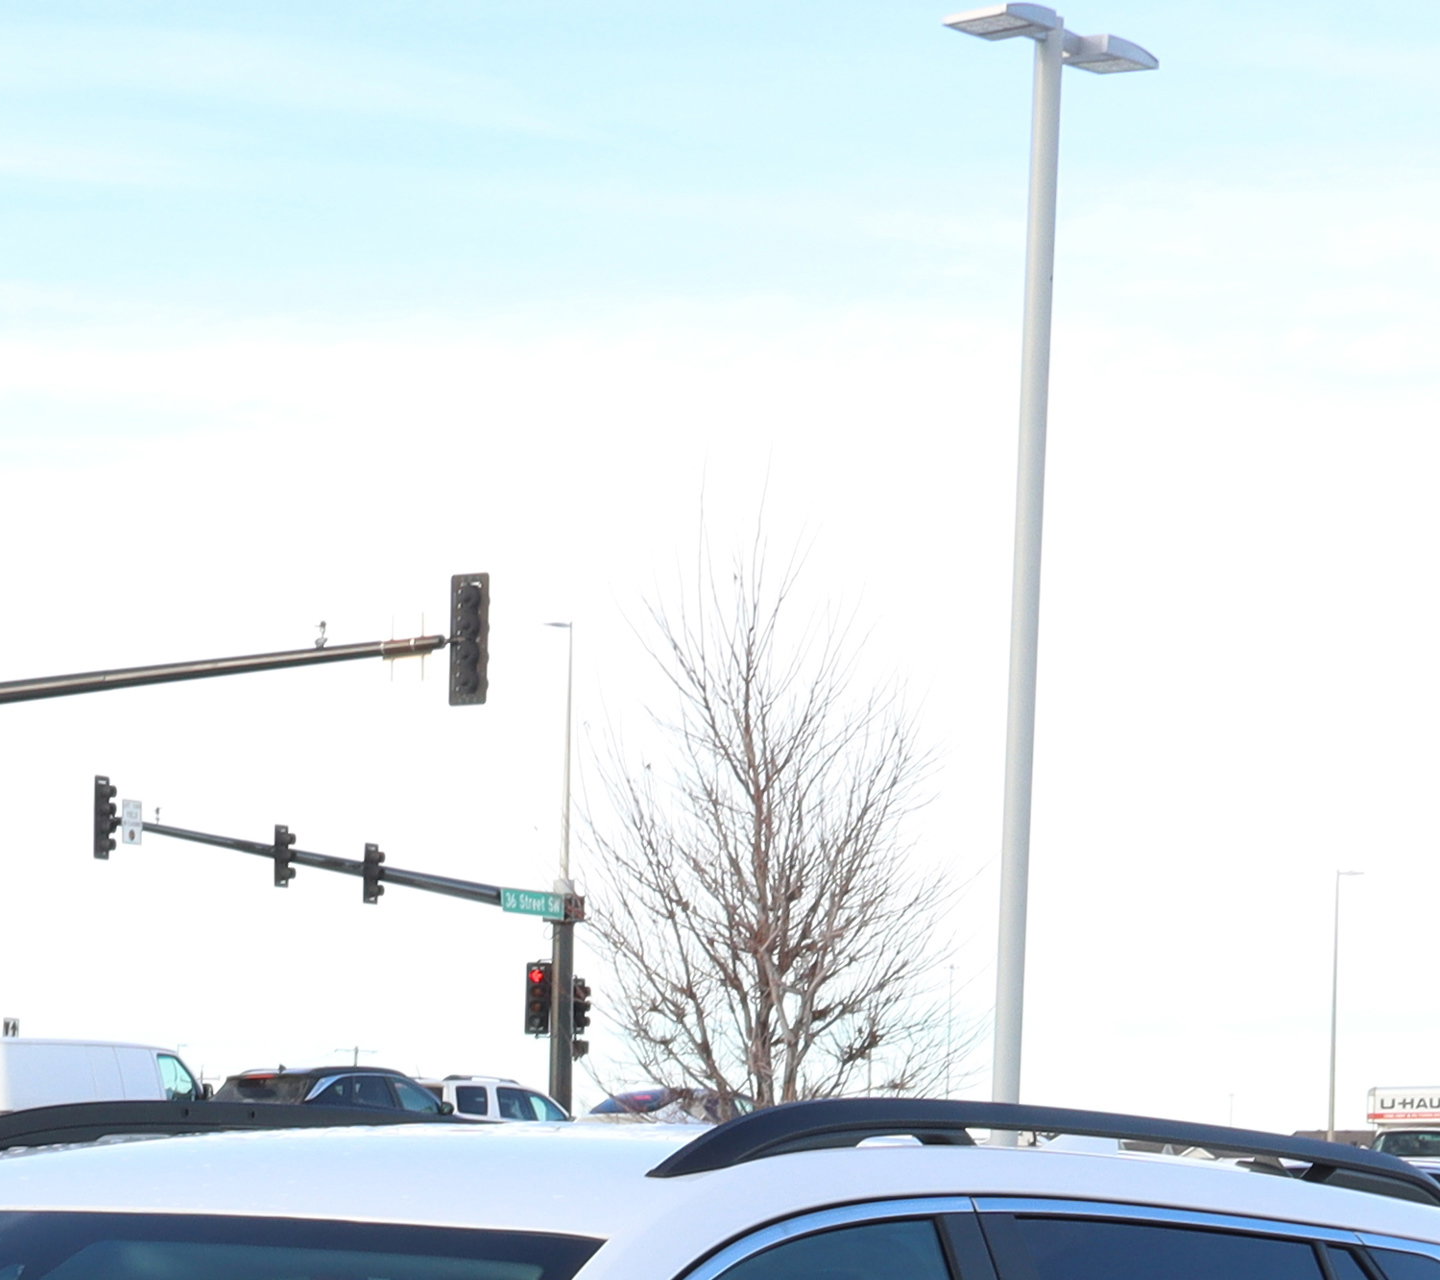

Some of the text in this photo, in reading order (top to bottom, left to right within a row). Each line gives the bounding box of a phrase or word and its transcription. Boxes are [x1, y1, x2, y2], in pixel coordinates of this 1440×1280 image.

[505, 892, 560, 912] 36 Street SW
